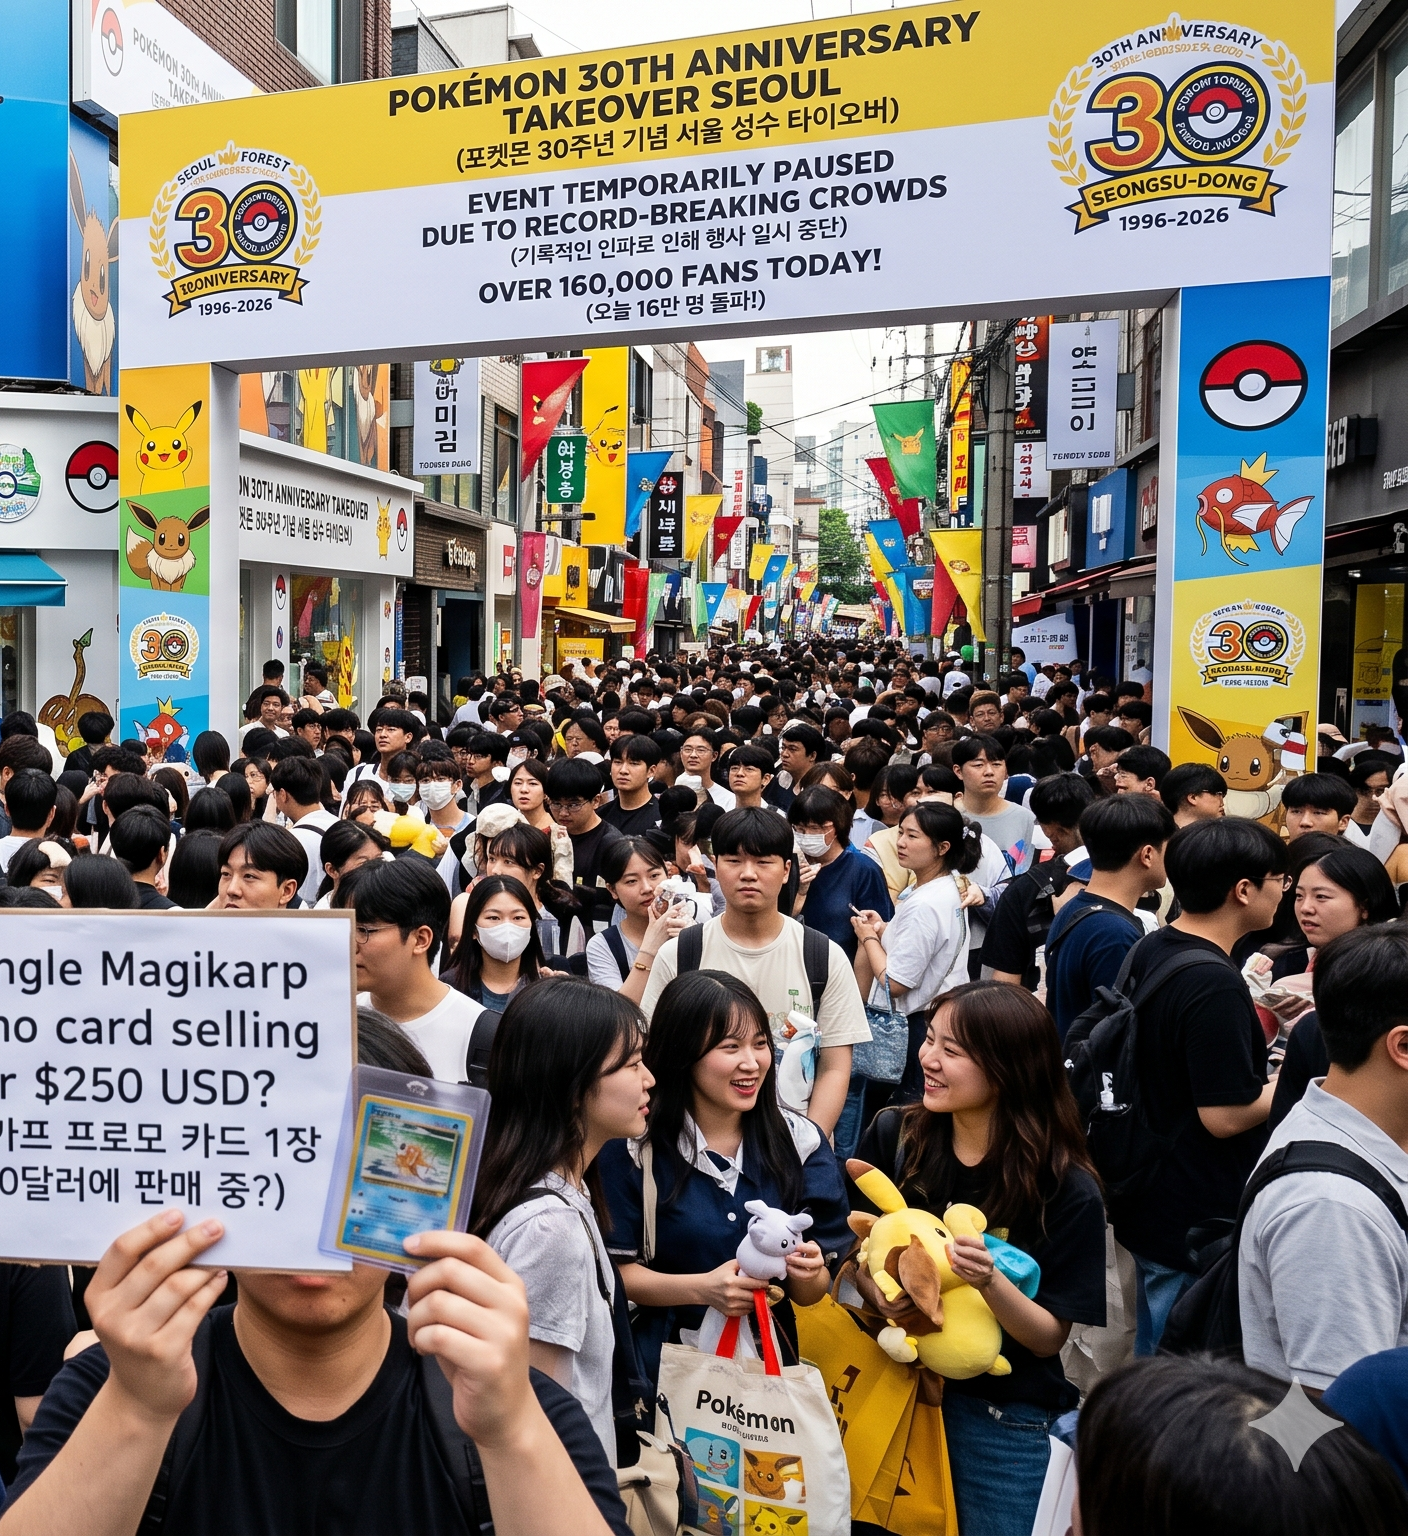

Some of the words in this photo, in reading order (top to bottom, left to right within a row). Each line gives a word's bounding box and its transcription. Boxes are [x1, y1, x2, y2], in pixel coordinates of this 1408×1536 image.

[133, 27, 178, 78] POKÉMON
[389, 68, 567, 117] POKÉMON
[578, 53, 674, 92] 30TH
[685, 10, 981, 78] ANNIVERSARY
[1091, 39, 1133, 69] 30TH
[1137, 24, 1262, 49] ANVERSARY
[503, 85, 699, 134] TAKEOVER
[710, 67, 841, 110] SEOUL
[1084, 60, 1271, 177] 30
[456, 140, 531, 173] (포켓몬
[537, 130, 614, 161] 30주년
[622, 124, 668, 152] 기념
[676, 117, 724, 146] 서울
[731, 112, 780, 141] 성수
[788, 97, 899, 133] 타이오버)
[177, 157, 216, 185] SEOUL
[241, 151, 291, 172] FOREST
[468, 185, 555, 214] EVENT
[562, 162, 765, 204] TEMPORARILY
[774, 150, 894, 183] PAUSED
[1091, 173, 1258, 208] SEONGSU-DONG
[174, 180, 298, 271] 30
[422, 223, 474, 247] DUE
[481, 218, 517, 242] TO
[525, 190, 800, 237] RECORD-BREAKING
[809, 174, 947, 210] CROWDS
[1119, 207, 1229, 231] 1996-2026
[511, 239, 592, 268] (기록적인
[598, 235, 655, 259] 인파로
[661, 229, 700, 253] 인해
[706, 225, 746, 249] 행사
[751, 221, 791, 245] 일시
[797, 216, 848, 241] 중단)
[479, 278, 552, 303] OVER
[559, 267, 673, 298] 160,000
[681, 259, 759, 287] FANS
[766, 248, 881, 279] TODAY!
[198, 298, 272, 316] 1996-2026
[586, 300, 632, 324] (오늘
[637, 295, 680, 317] 16만
[685, 295, 704, 315] 명
[710, 289, 766, 314] 돌파!)
[251, 478, 273, 502] 30TH
[275, 483, 330, 513] ANNIVERSARY
[332, 495, 369, 520] TAKEOVER
[1208, 620, 1288, 663] 30
[101, 950, 308, 999] Magikarp
[55, 1009, 153, 1046] card
[172, 1010, 321, 1059] selling
[34, 1061, 143, 1105] $250
[162, 1069, 276, 1107] USD?
[65, 1121, 166, 1154] 프로모
[181, 1123, 250, 1159] 카드
[263, 1125, 321, 1163] 1장
[134, 1170, 201, 1206] 판매
[217, 1171, 286, 1211] 중?)
[695, 1389, 795, 1434] Pokémon
